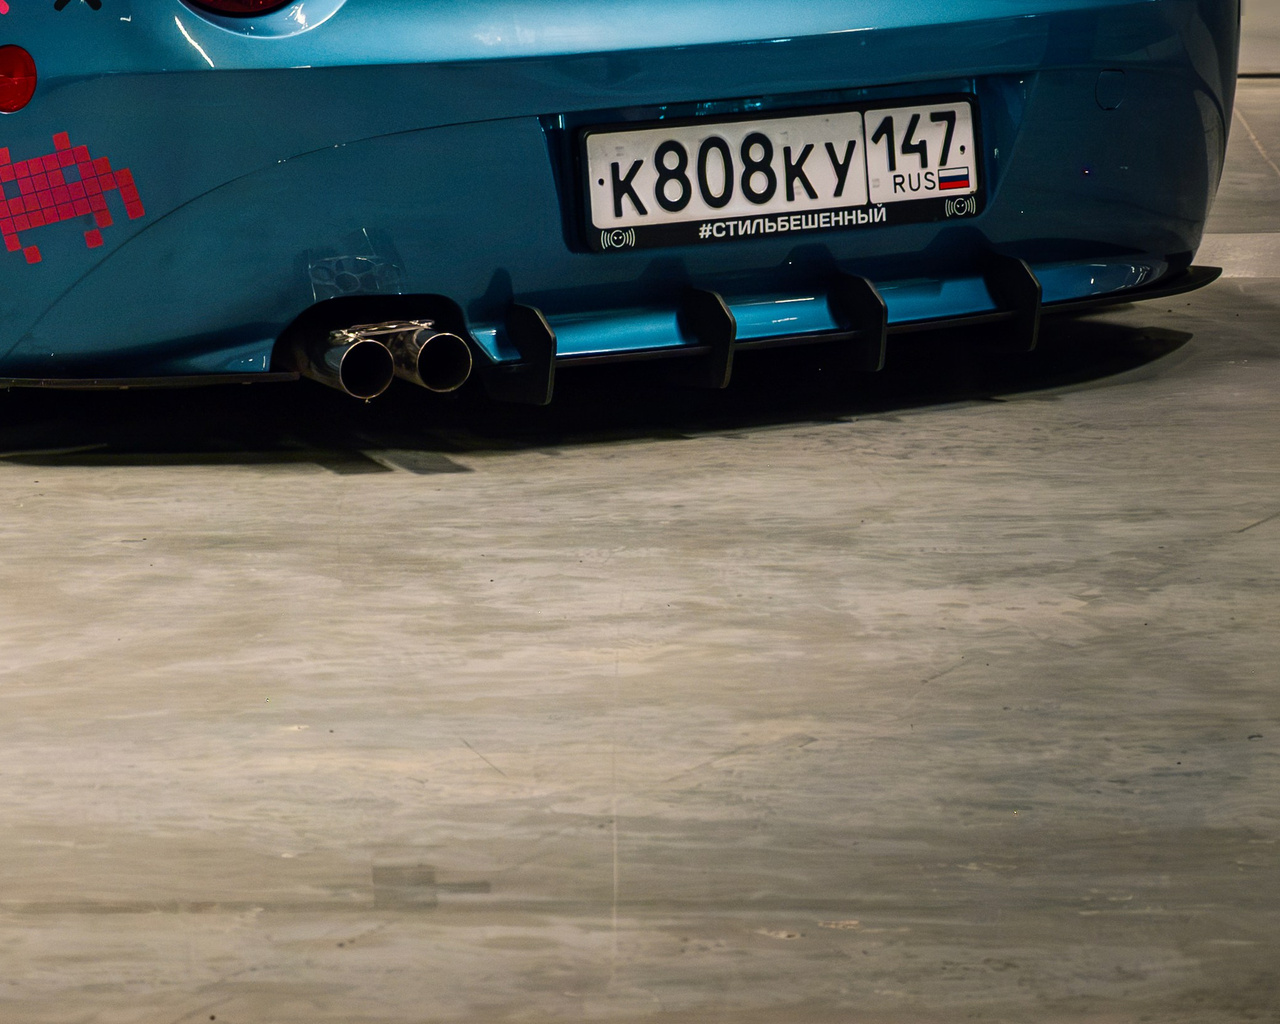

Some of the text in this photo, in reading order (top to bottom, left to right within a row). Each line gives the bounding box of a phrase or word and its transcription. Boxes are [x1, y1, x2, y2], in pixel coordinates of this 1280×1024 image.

[871, 110, 958, 172] 147
[892, 171, 937, 195] RUS
[699, 203, 888, 240] #СТИЛЬБЕШЕННЫЙ
